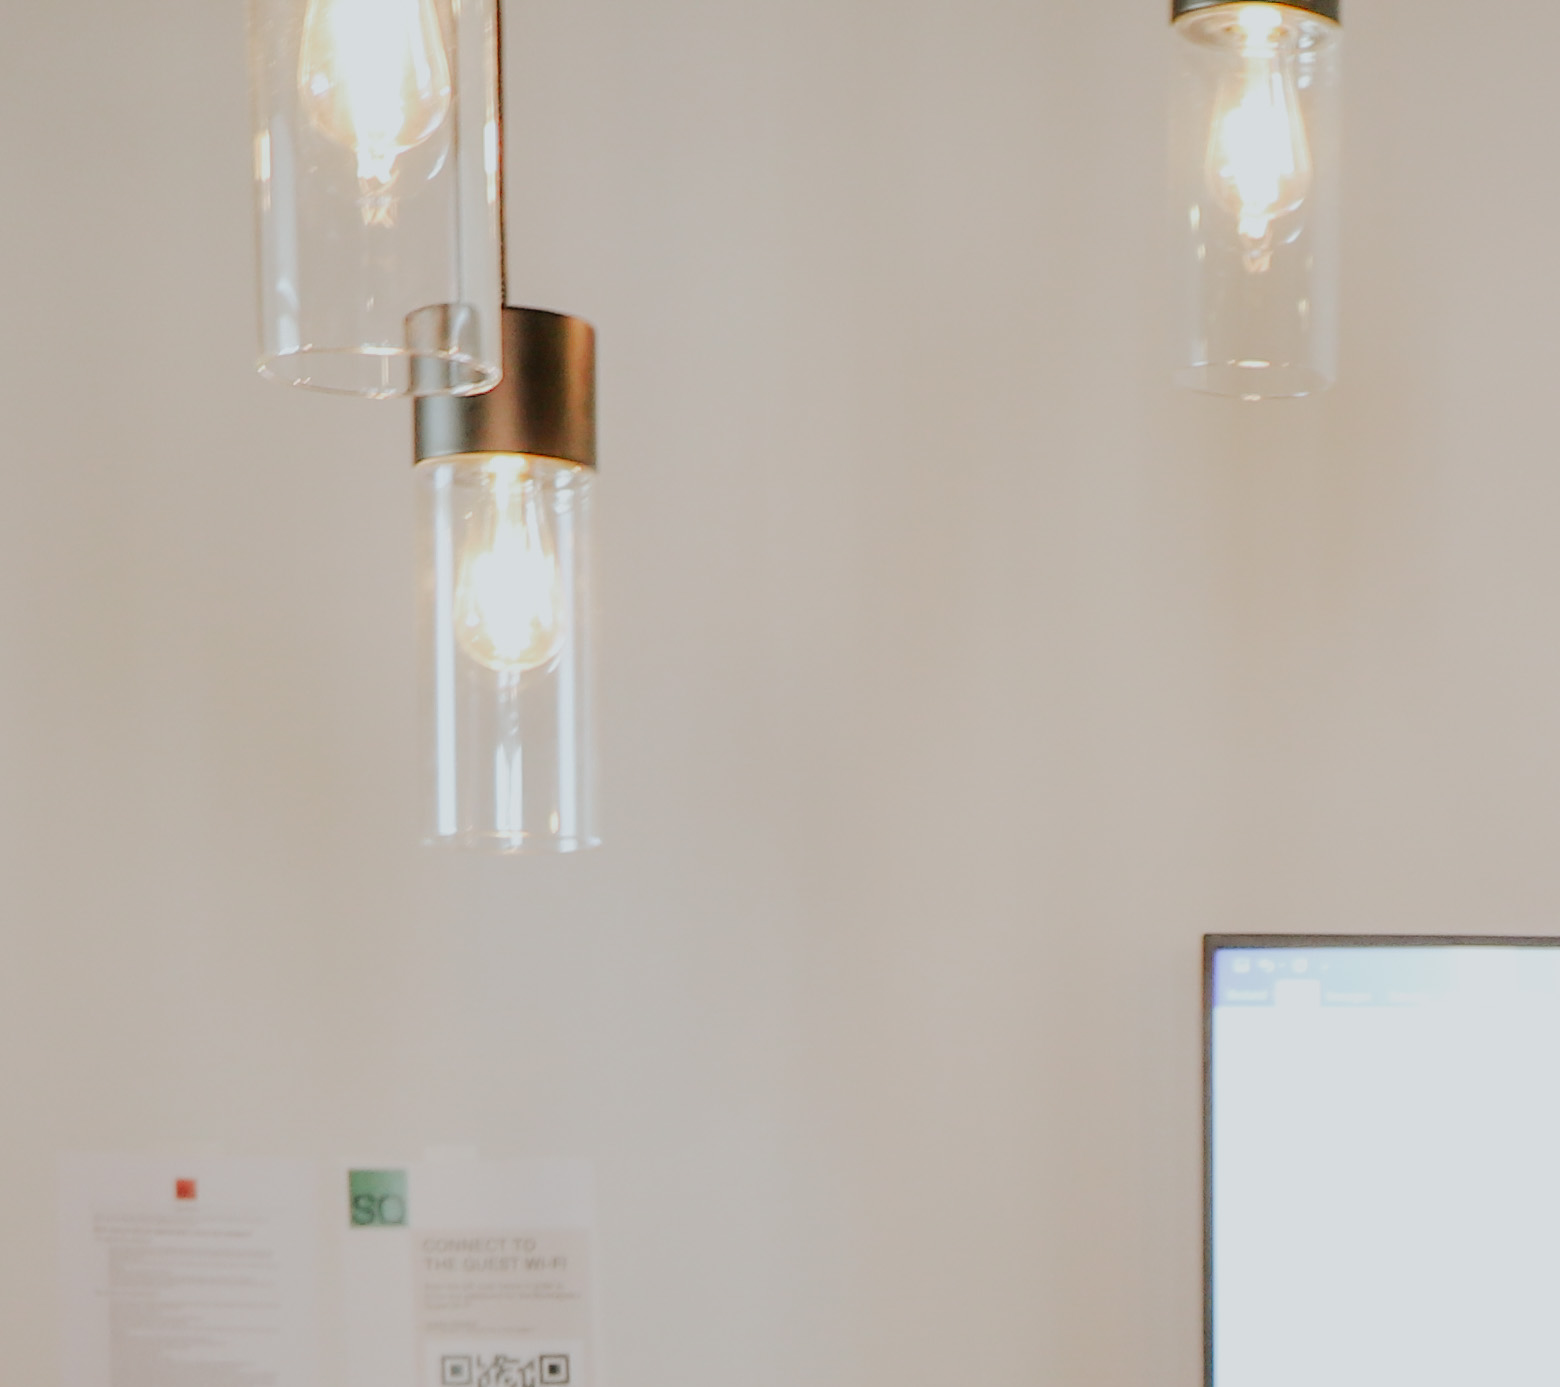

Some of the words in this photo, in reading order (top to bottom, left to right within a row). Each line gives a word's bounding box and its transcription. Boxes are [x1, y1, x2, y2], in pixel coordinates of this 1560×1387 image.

[423, 1238, 506, 1253] CONNECT
[511, 1238, 537, 1253] TO
[424, 1257, 455, 1271] THE
[463, 1257, 520, 1271] GUEST
